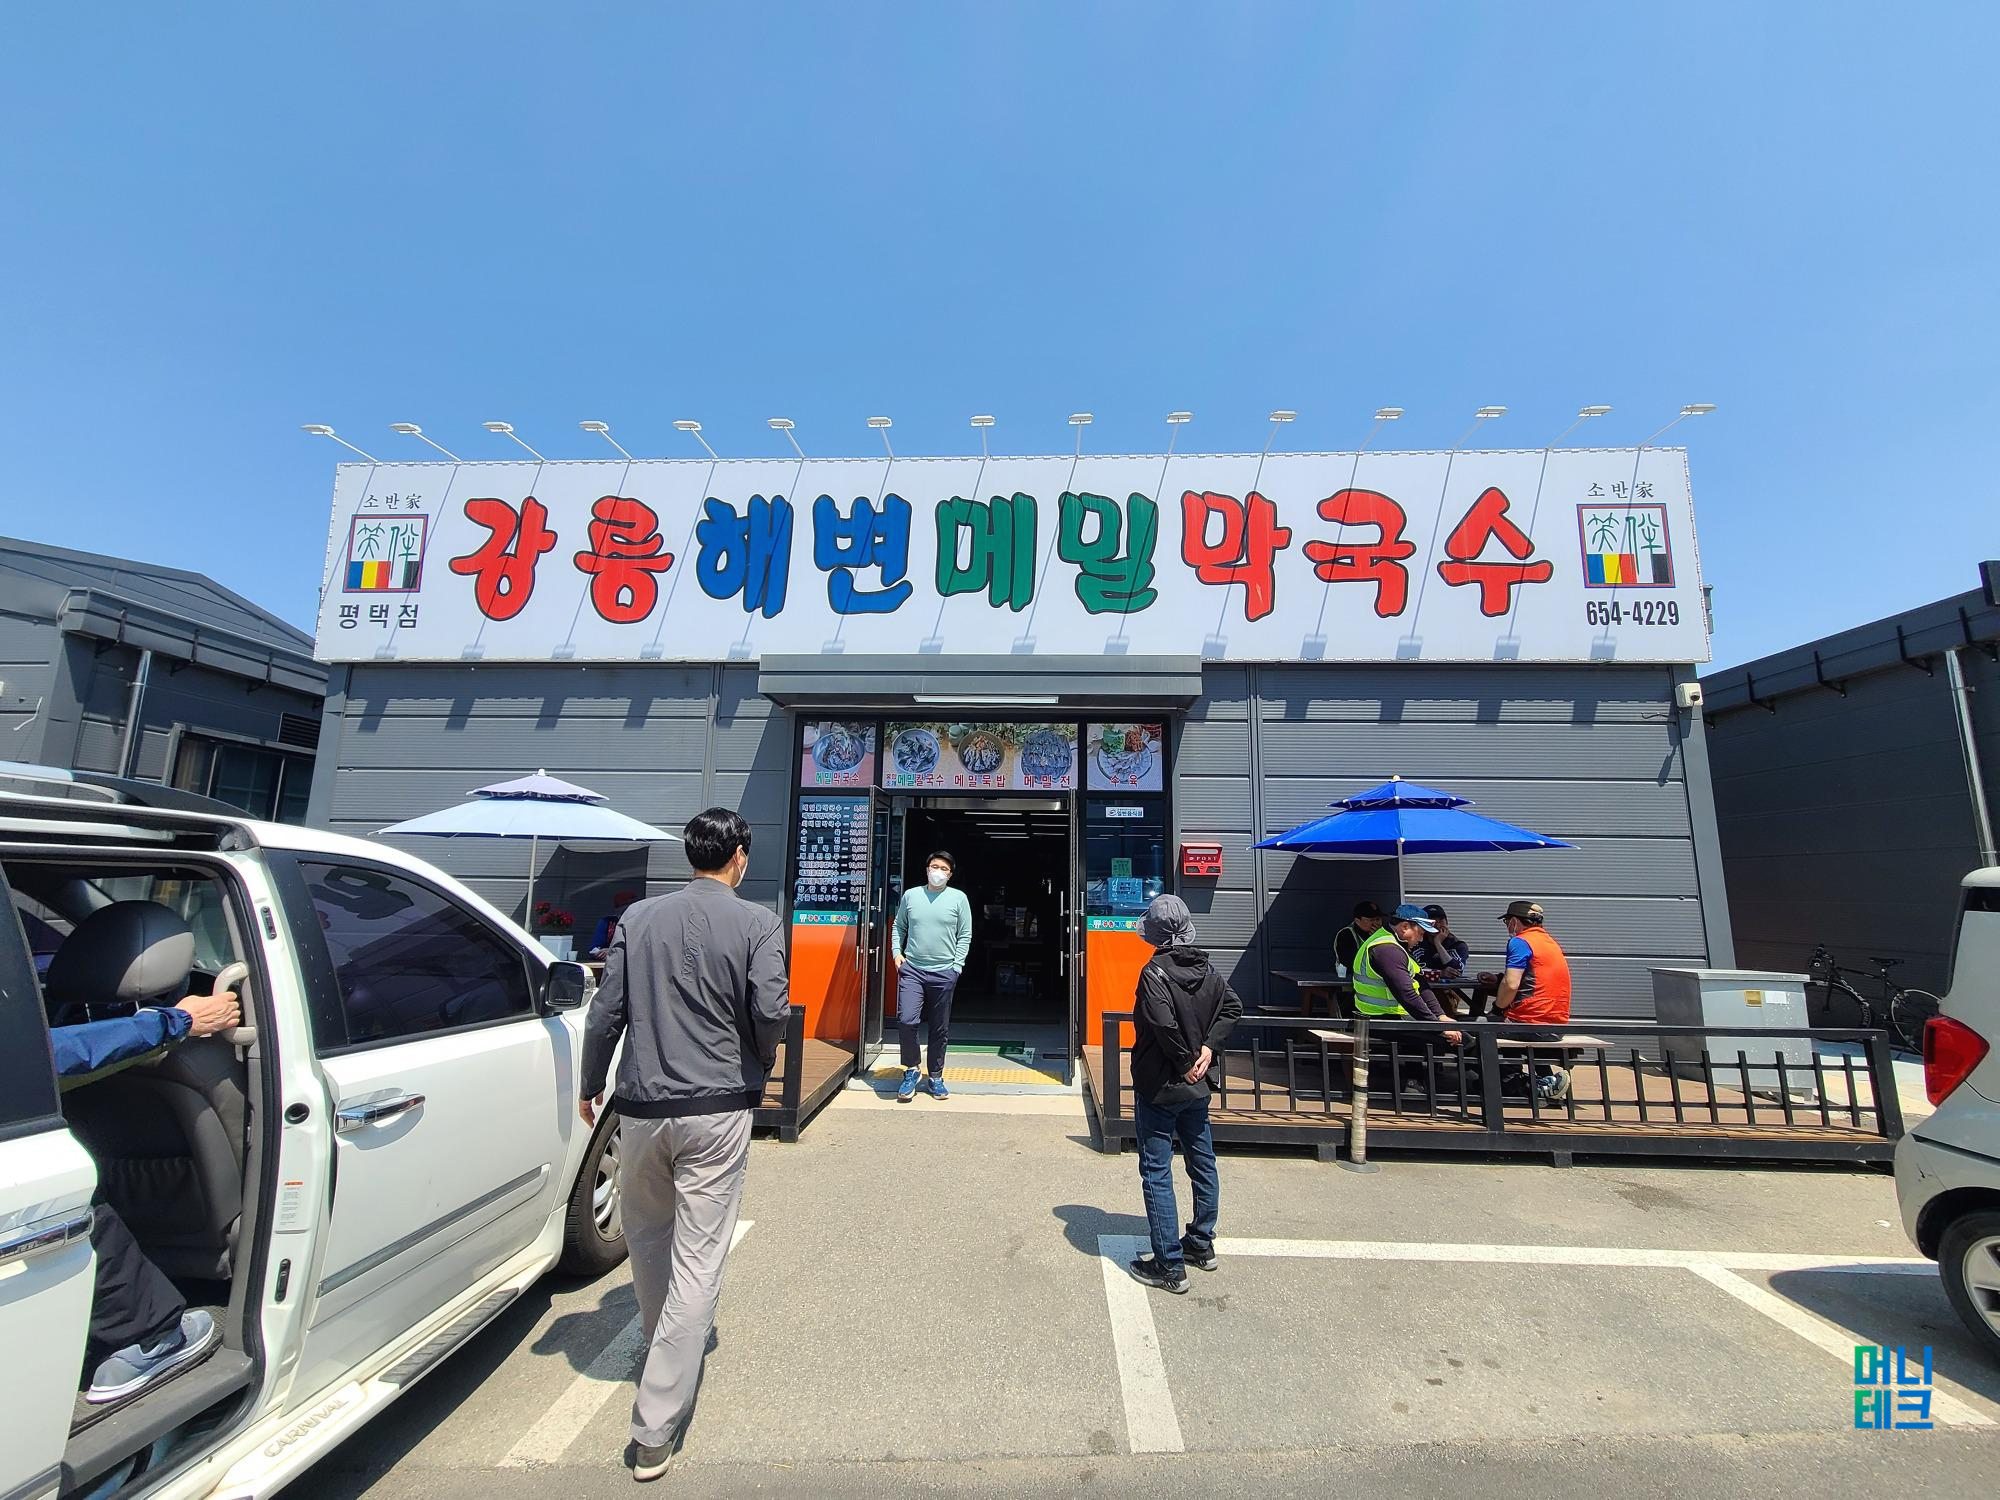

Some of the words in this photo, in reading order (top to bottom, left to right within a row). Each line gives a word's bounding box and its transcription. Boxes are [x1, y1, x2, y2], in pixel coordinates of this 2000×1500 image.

[1588, 481, 1654, 498] 소반家
[363, 492, 422, 509] 소반家
[338, 604, 419, 629] 평택점
[1585, 600, 1680, 625] 654-4229
[815, 771, 860, 784] 메밀막국수
[897, 773, 944, 787] 메밀칼국수
[954, 774, 1006, 787] 메밀묵밥
[1023, 774, 1071, 788] 메밀전
[1110, 774, 1137, 787] 수육
[263, 1400, 350, 1457] CARNIVAL
